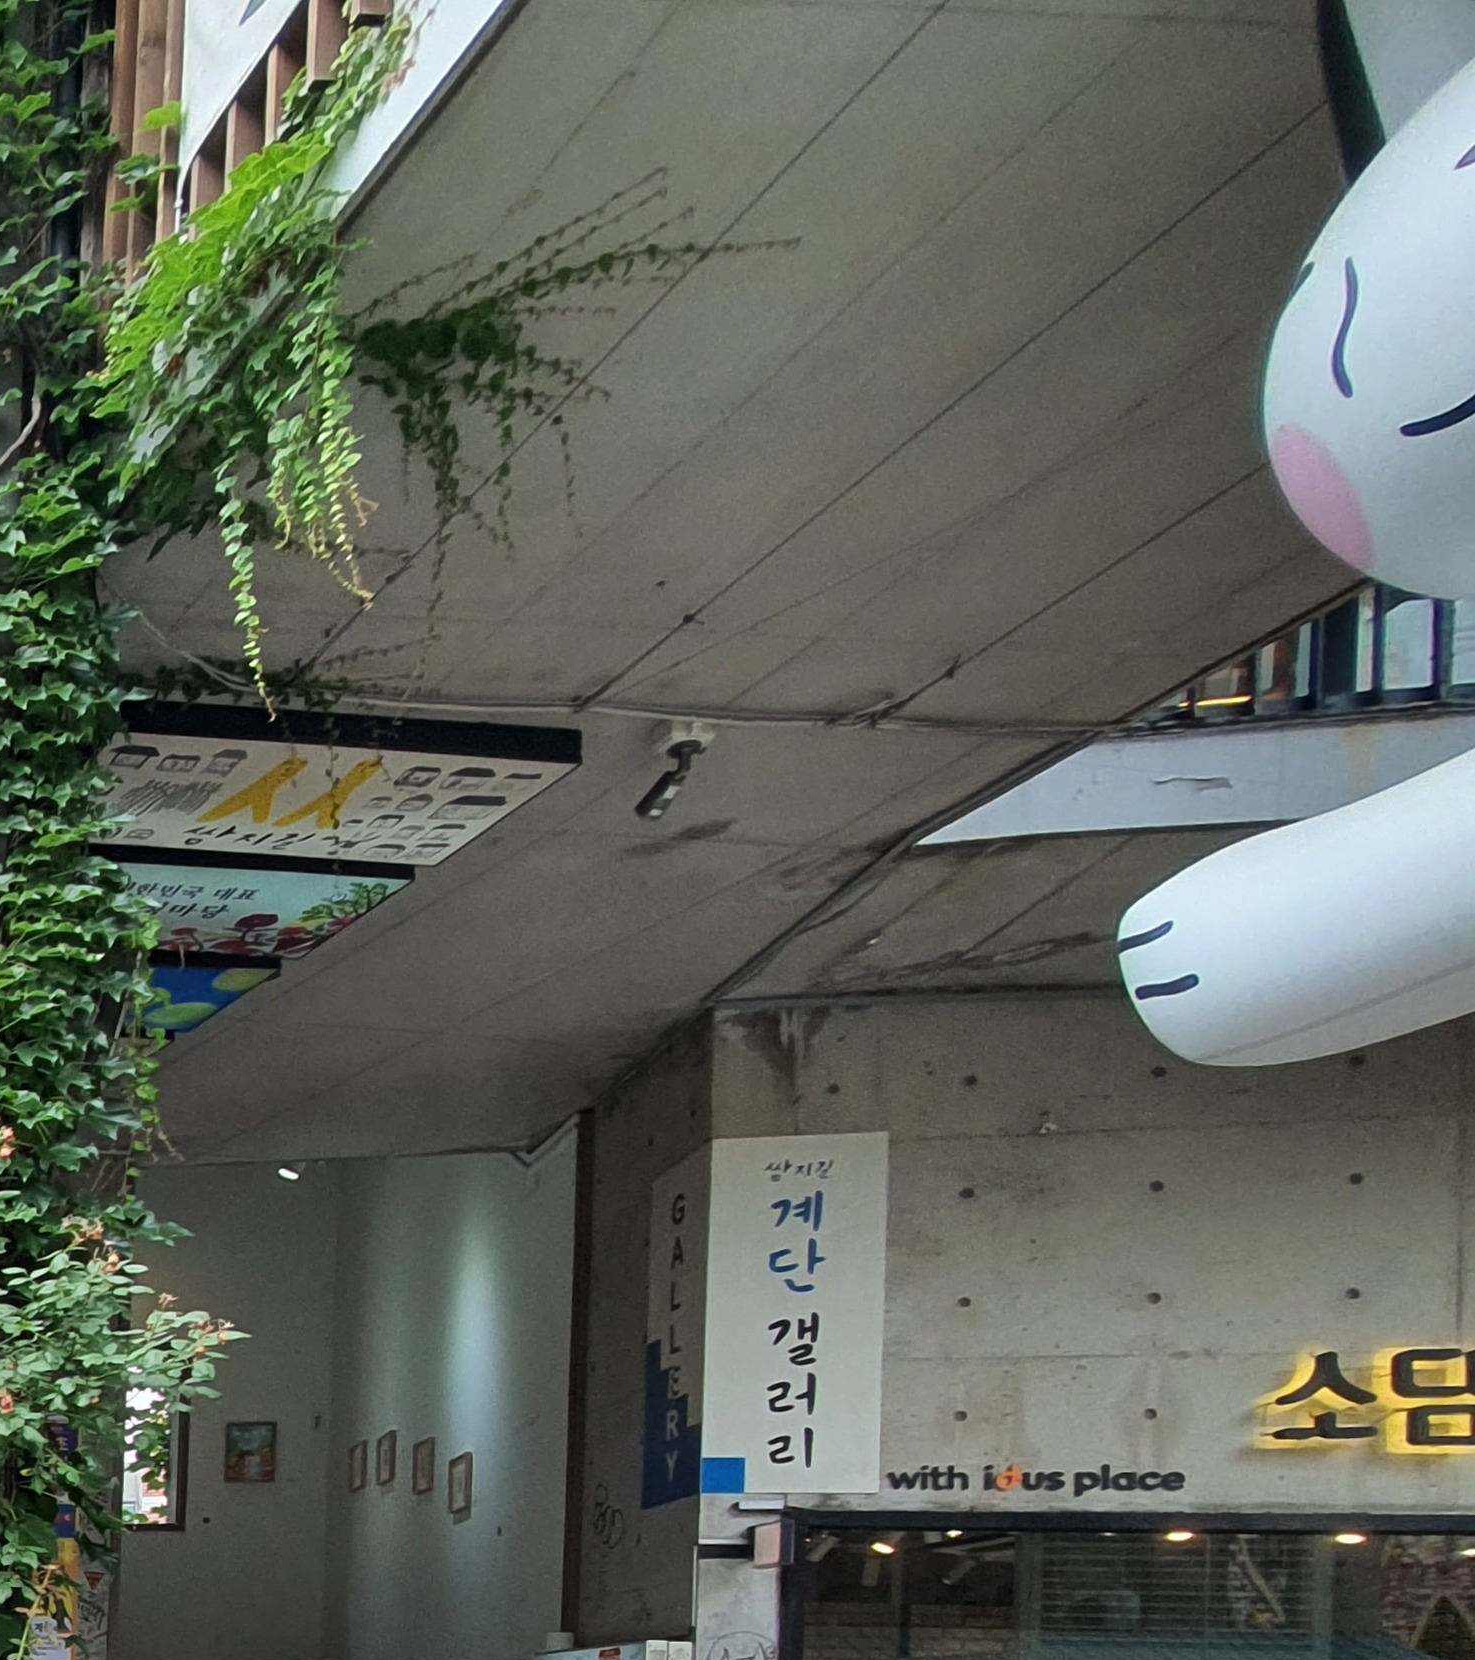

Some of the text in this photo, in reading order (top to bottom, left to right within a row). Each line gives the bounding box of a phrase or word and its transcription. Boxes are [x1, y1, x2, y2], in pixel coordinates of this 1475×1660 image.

[182, 825, 317, 850] 쌈지길
[126, 881, 260, 902] 한민국 대표
[148, 901, 230, 919] 마당
[764, 1158, 835, 1183] 쌈지길
[664, 1192, 688, 1482] GALLERY
[766, 1190, 827, 1469] 계단 갤러리
[887, 1465, 970, 1492] with
[1074, 1464, 1186, 1498] place
